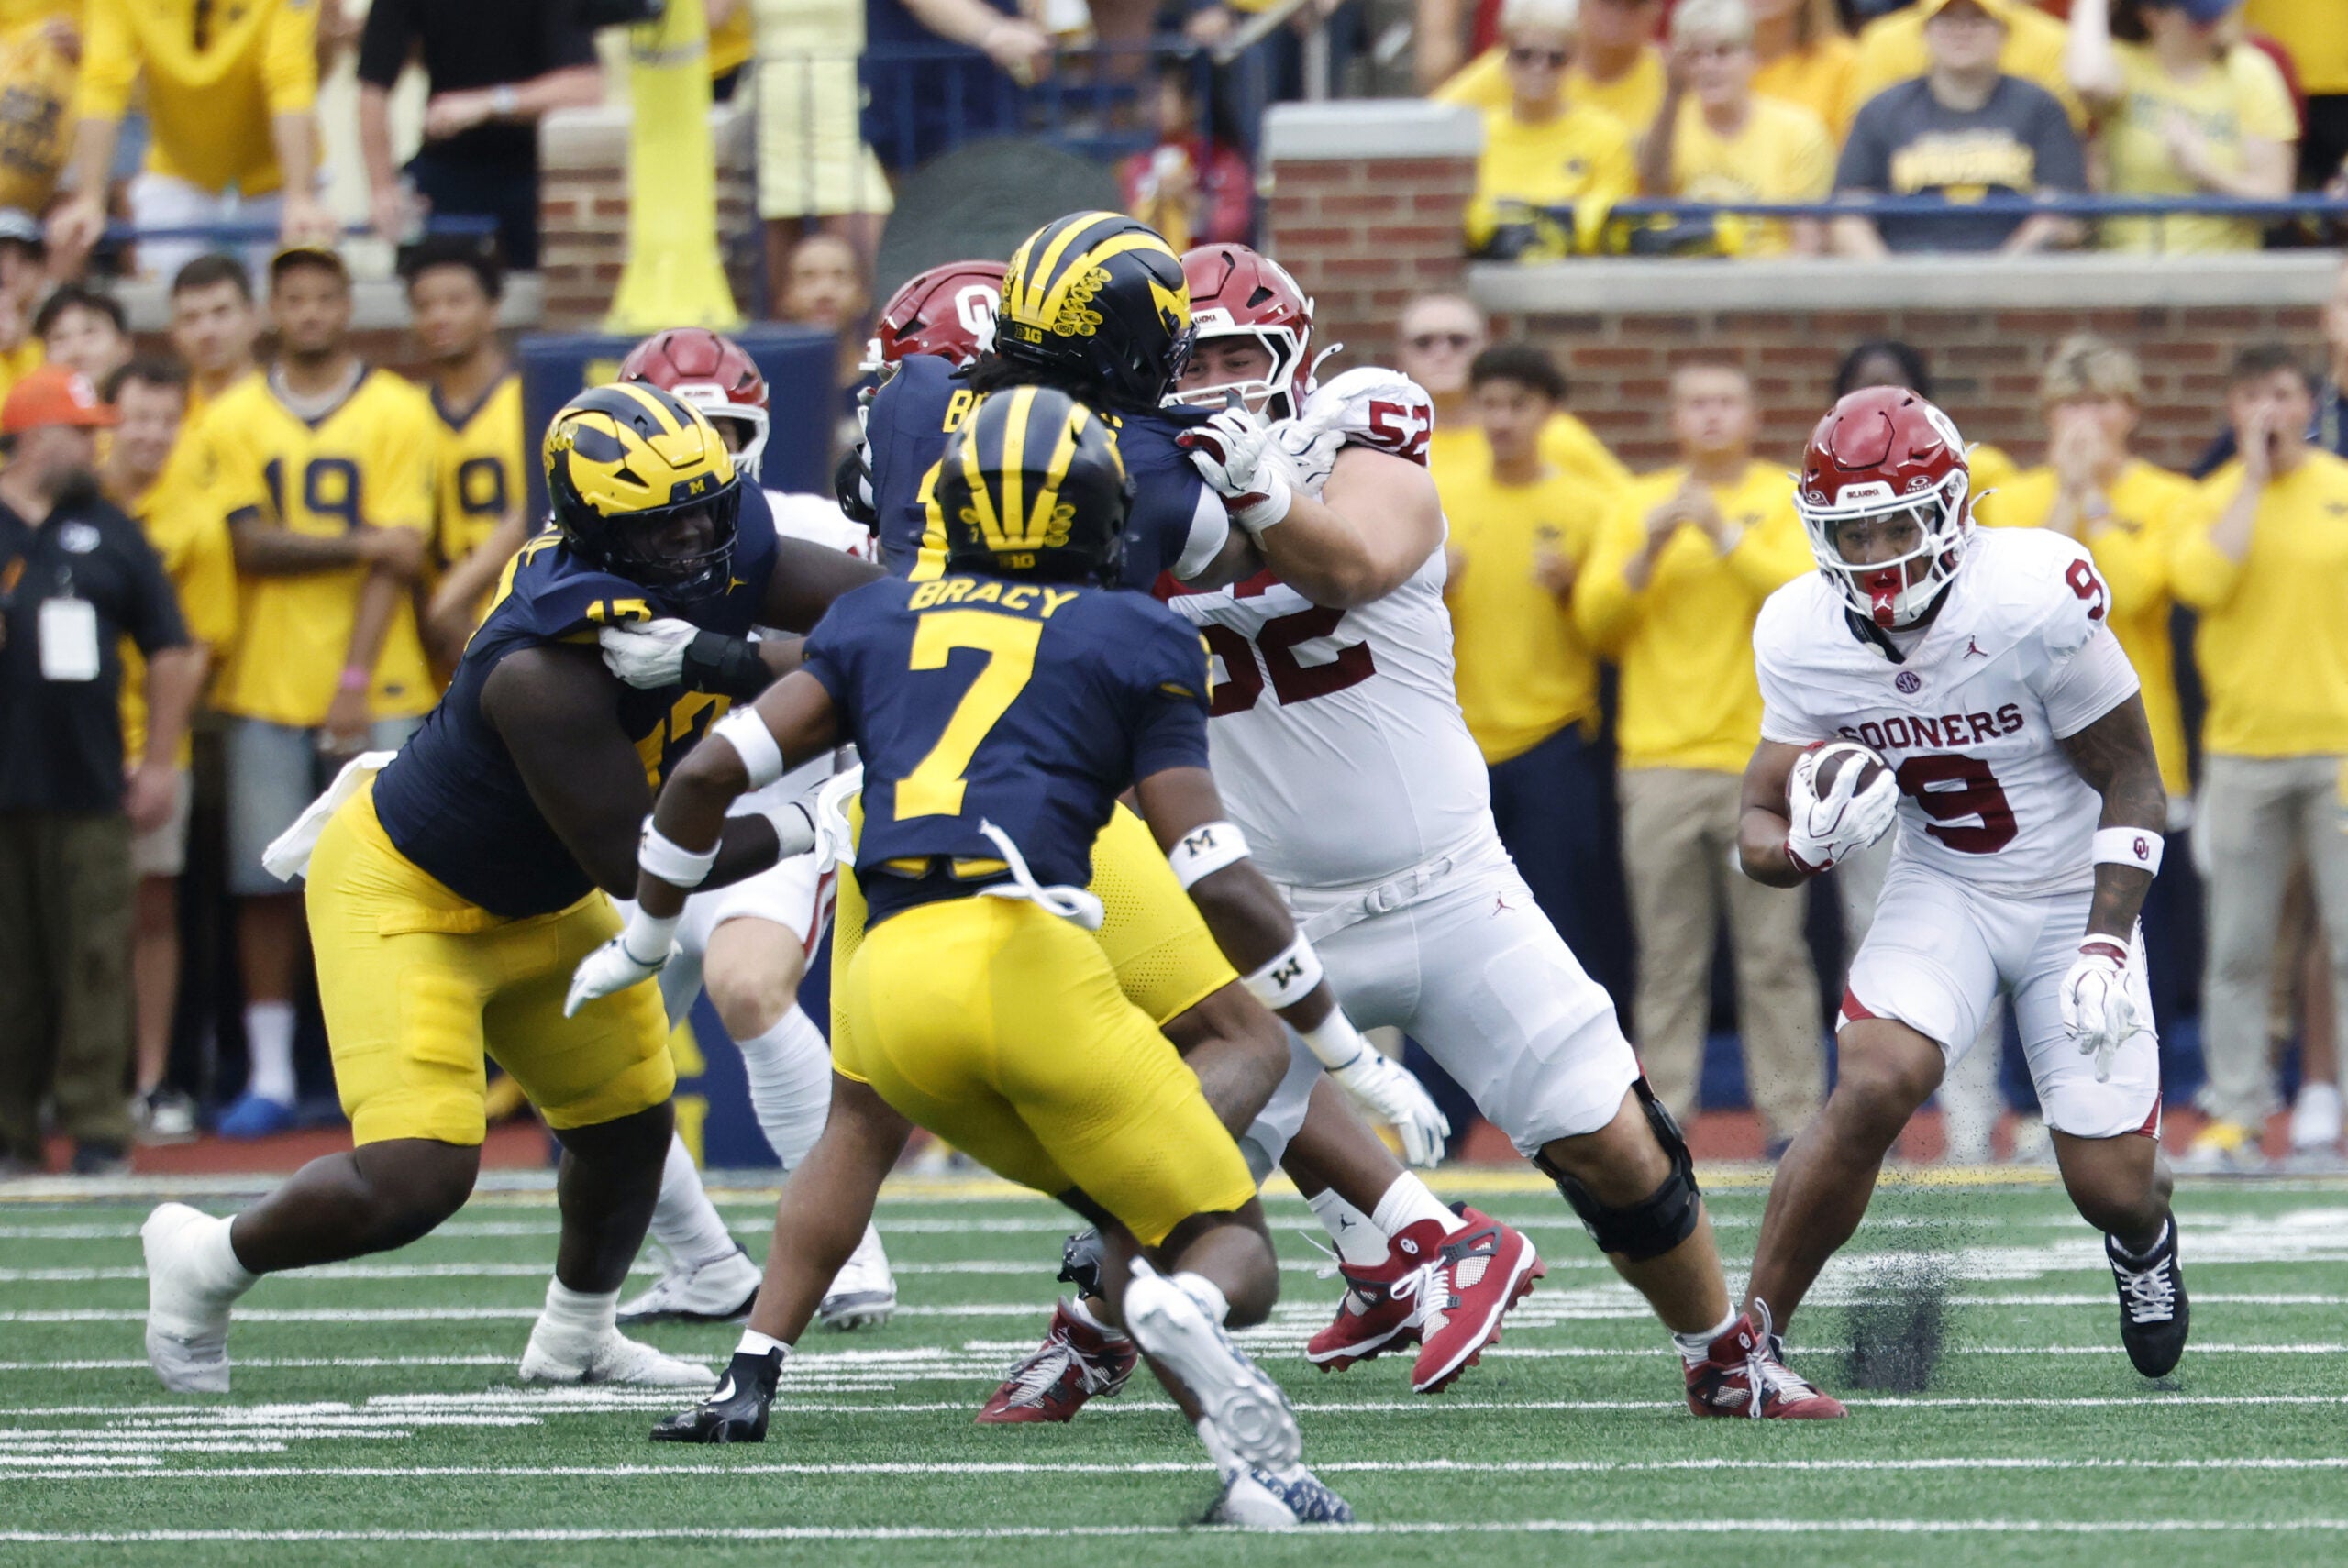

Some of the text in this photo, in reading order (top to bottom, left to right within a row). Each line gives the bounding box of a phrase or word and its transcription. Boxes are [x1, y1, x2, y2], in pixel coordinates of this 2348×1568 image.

[1369, 400, 1431, 468] 52
[264, 457, 360, 528] 19
[689, 478, 705, 496] M
[907, 577, 1080, 619] BRACY
[2066, 558, 2105, 620] 9
[1152, 565, 1377, 717] 52
[1896, 671, 1921, 693] SEC
[893, 608, 1045, 823] 7
[1837, 702, 2024, 750] SOONERS
[1896, 754, 2019, 854] 9
[1183, 829, 1217, 856] M
[2133, 836, 2150, 861] OU
